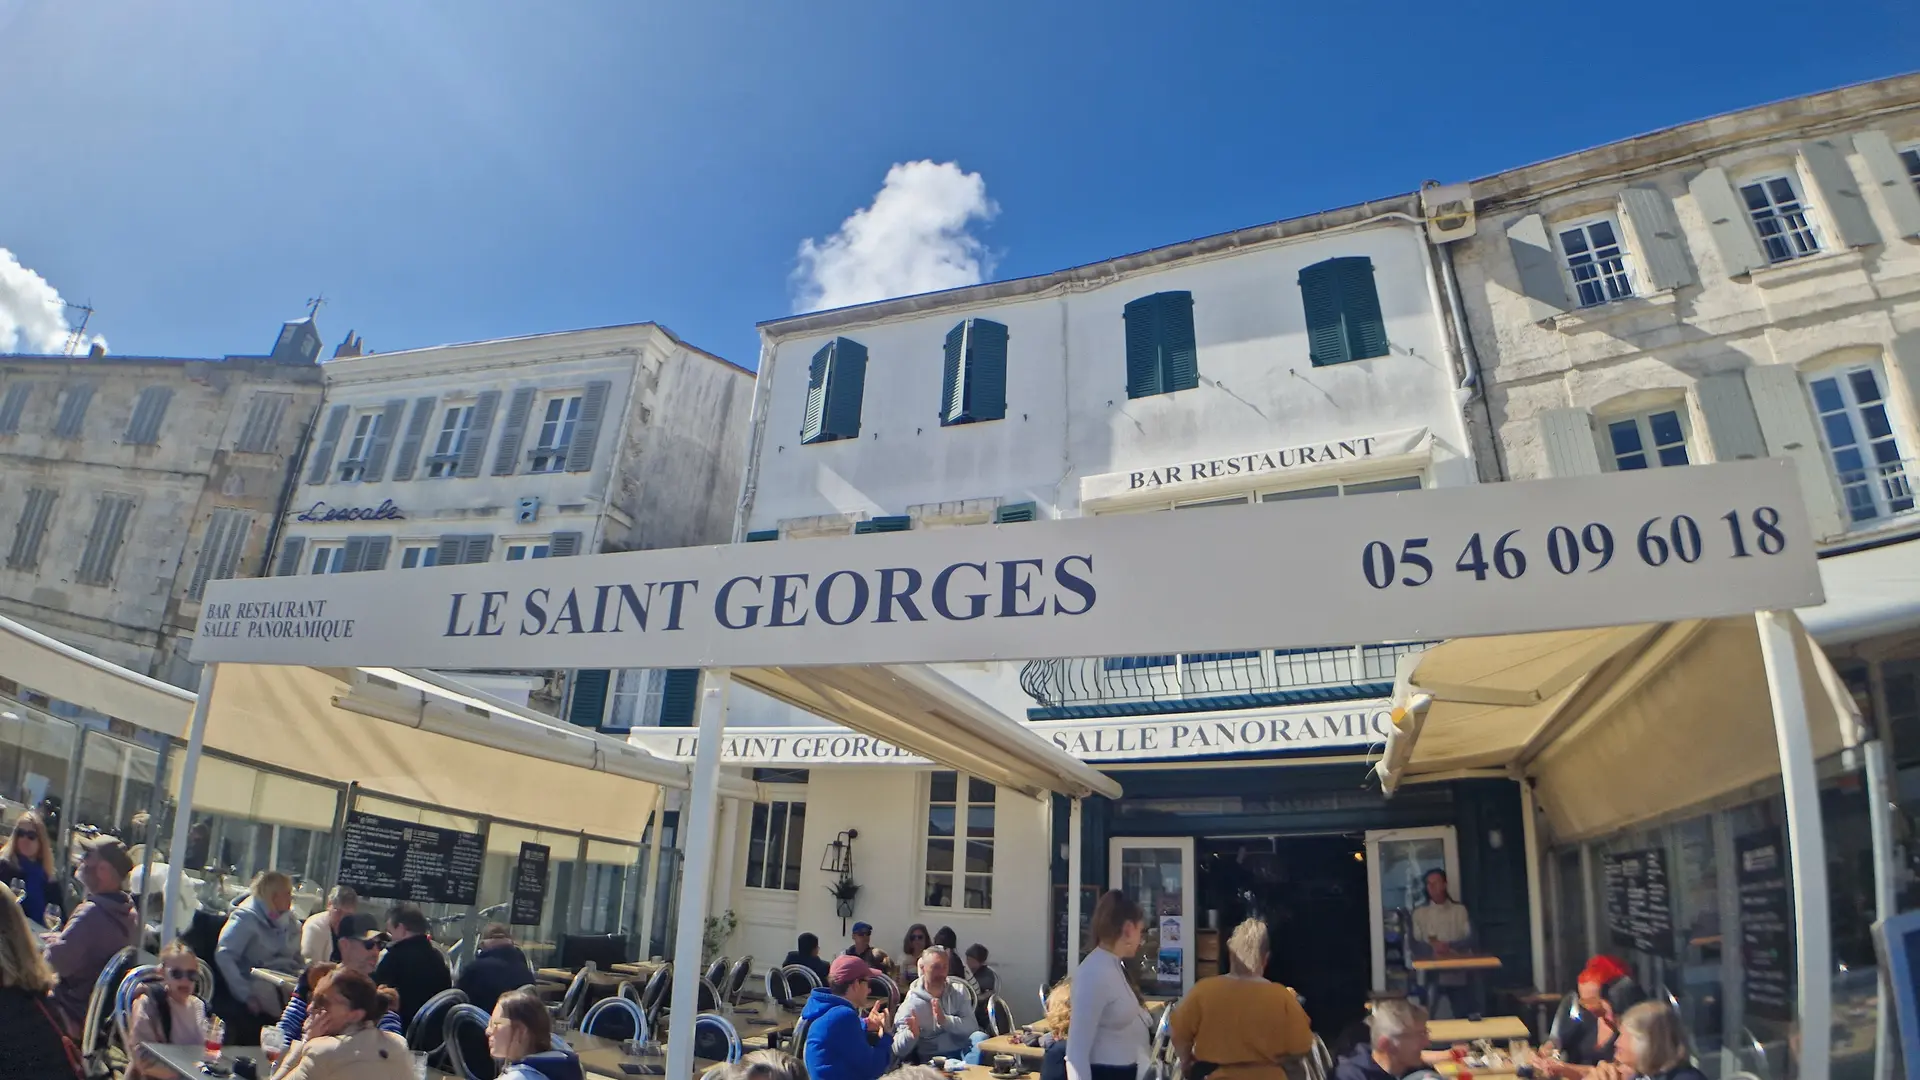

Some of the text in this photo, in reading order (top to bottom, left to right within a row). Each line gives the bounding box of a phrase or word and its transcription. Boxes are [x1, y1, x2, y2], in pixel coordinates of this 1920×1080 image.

[1130, 437, 1375, 490] BAR RESTAURANT
[1363, 506, 1786, 590] 05 46 09 60 18
[444, 554, 1097, 637] LE SAINT GEORGES
[206, 600, 327, 619] BAR RESTAURANT
[203, 619, 355, 642] SALLE PANORAMIQUE
[721, 737, 787, 758] AINT
[1052, 726, 1159, 753] SALLE
